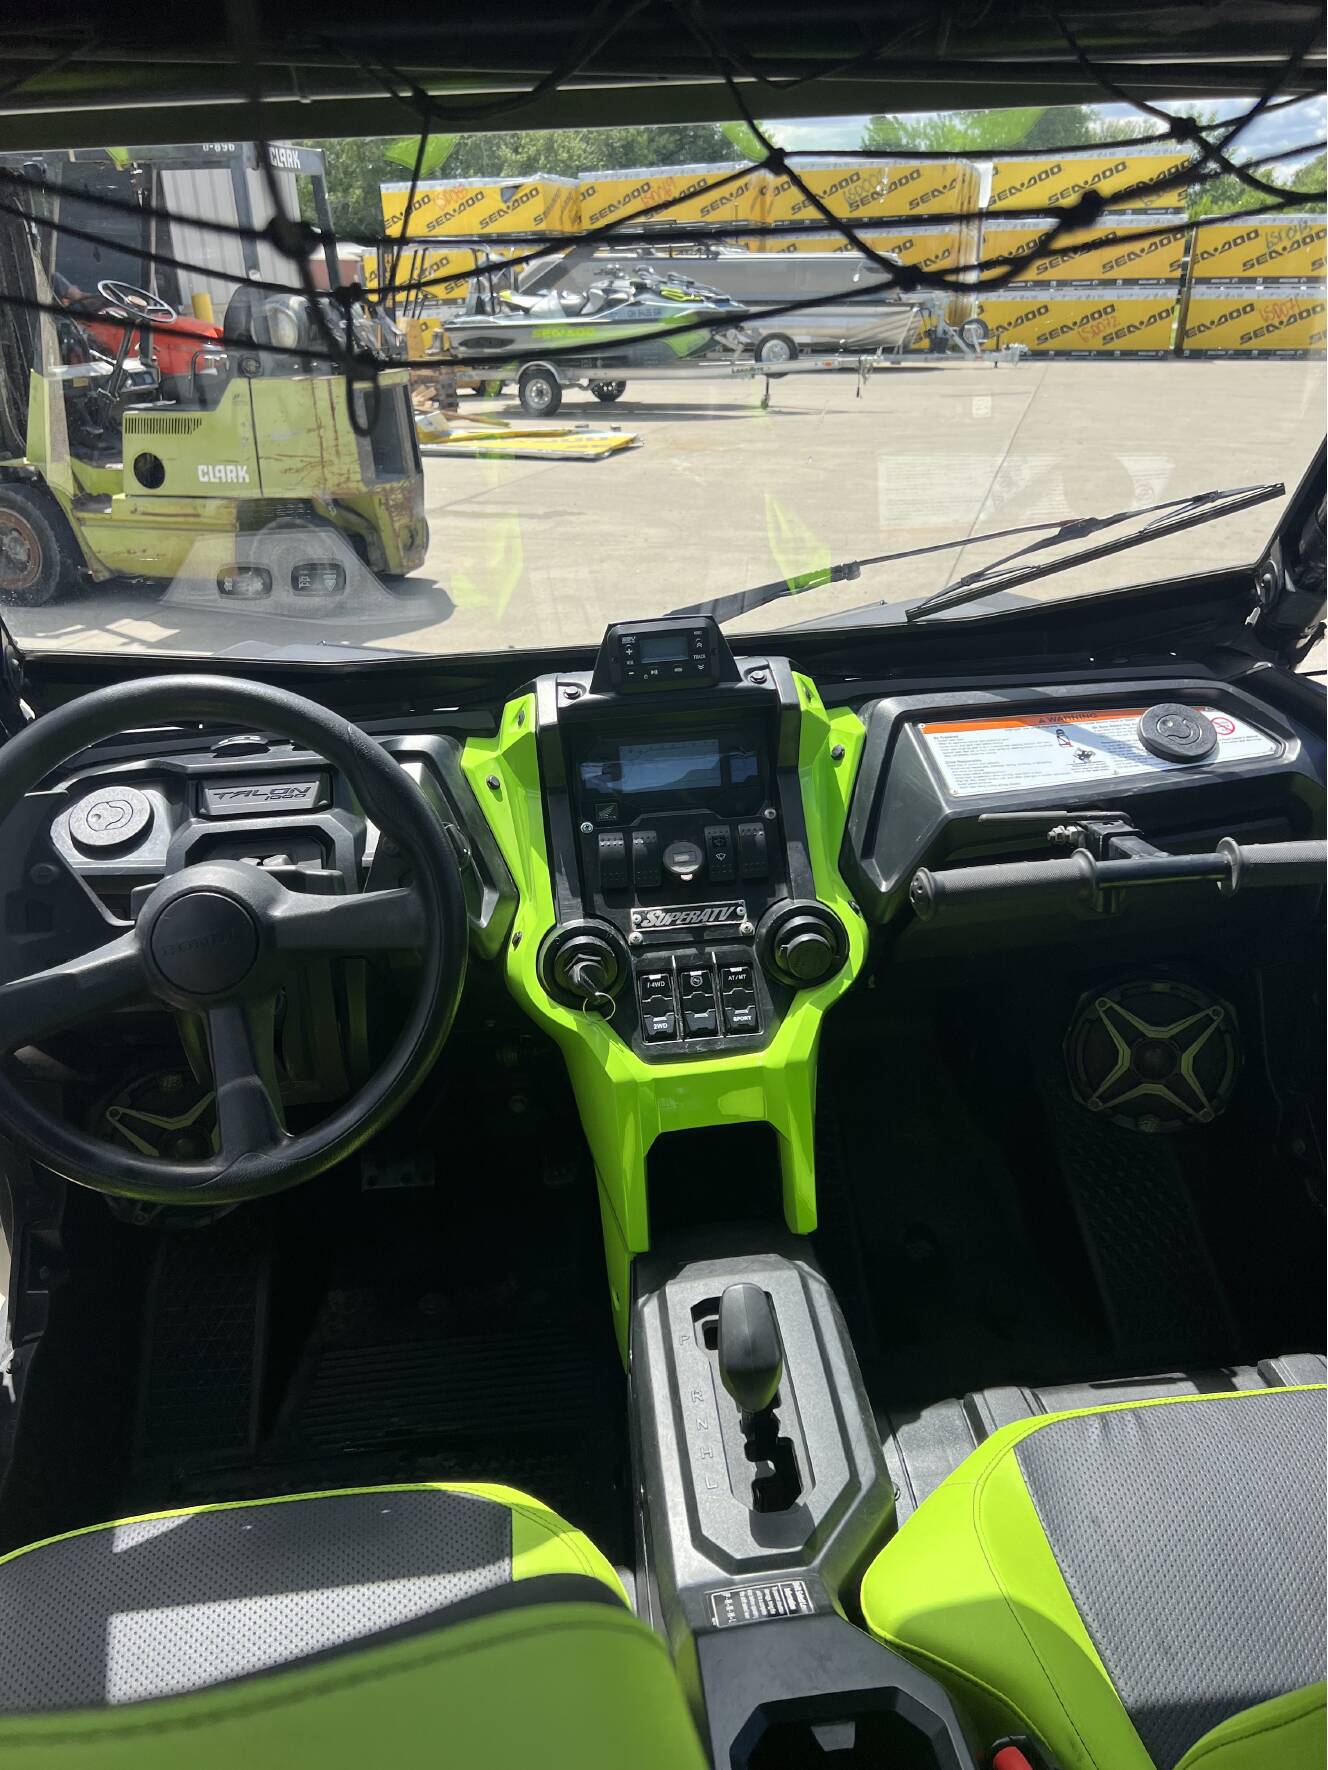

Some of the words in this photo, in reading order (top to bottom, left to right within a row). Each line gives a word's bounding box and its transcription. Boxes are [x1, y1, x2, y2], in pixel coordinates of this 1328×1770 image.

[269, 147, 301, 169] CLARK
[198, 465, 250, 483] CLARK
[1047, 712, 1098, 723] WARNING
[213, 786, 312, 800] TALON
[679, 1335, 690, 1346] P
[692, 1390, 704, 1402] R
[696, 1418, 709, 1430] N
[700, 1447, 713, 1459] H
[706, 1478, 718, 1489] L
